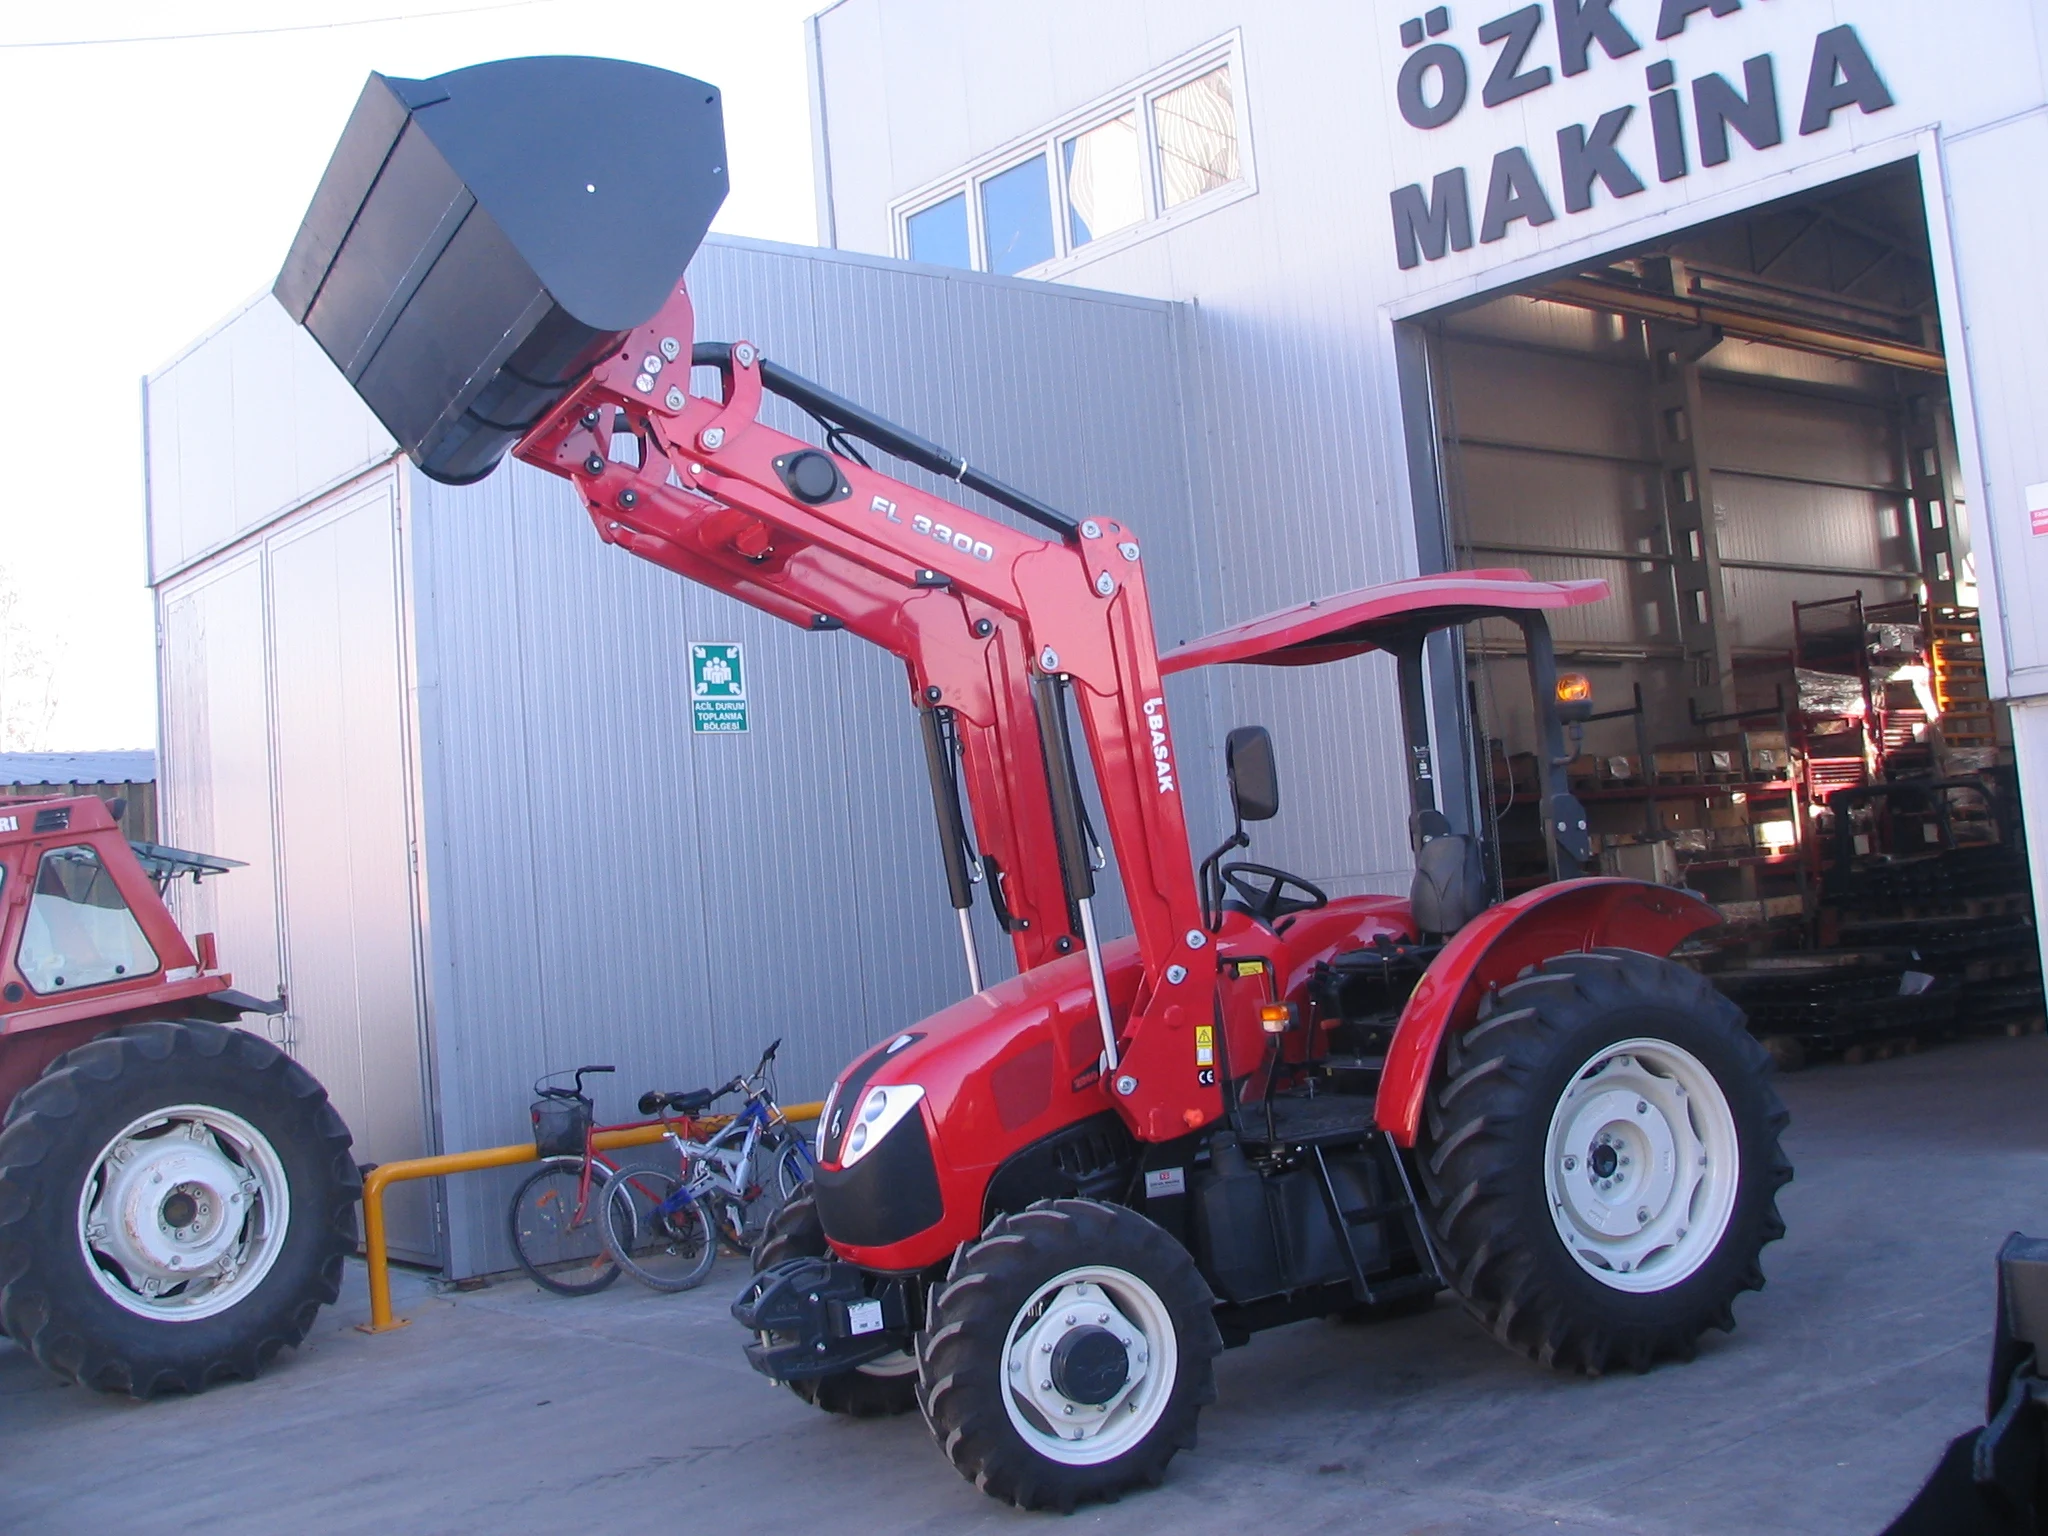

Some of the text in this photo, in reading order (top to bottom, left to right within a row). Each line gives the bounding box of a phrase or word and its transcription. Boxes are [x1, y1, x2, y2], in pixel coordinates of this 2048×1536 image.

[1390, 24, 1895, 270] MAKİNA
[870, 495, 994, 562] FL 3300
[715, 702, 744, 711] DURUM
[698, 712, 743, 721] TOPLANMA
[1199, 1070, 1214, 1084] CE
